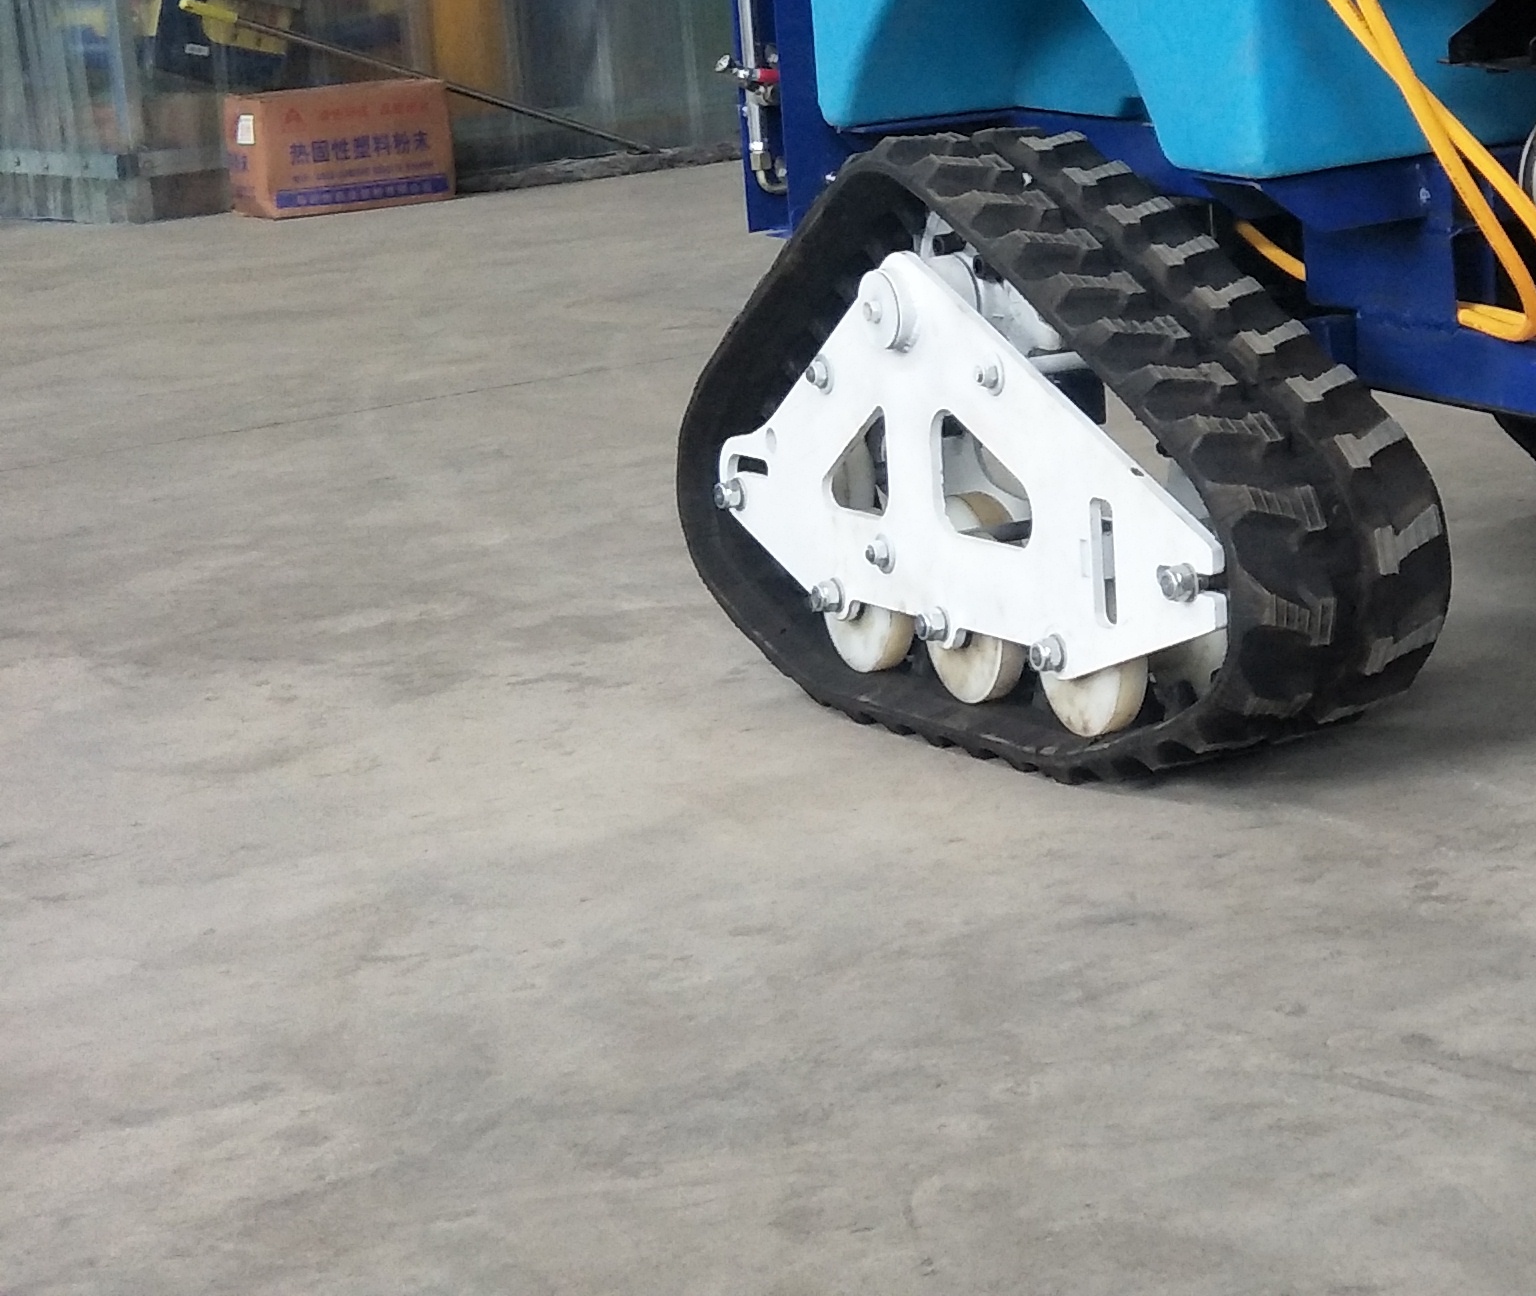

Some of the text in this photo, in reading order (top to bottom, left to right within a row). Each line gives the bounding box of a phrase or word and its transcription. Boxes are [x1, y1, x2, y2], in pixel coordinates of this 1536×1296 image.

[290, 131, 430, 164] 热固性塑料粉末
